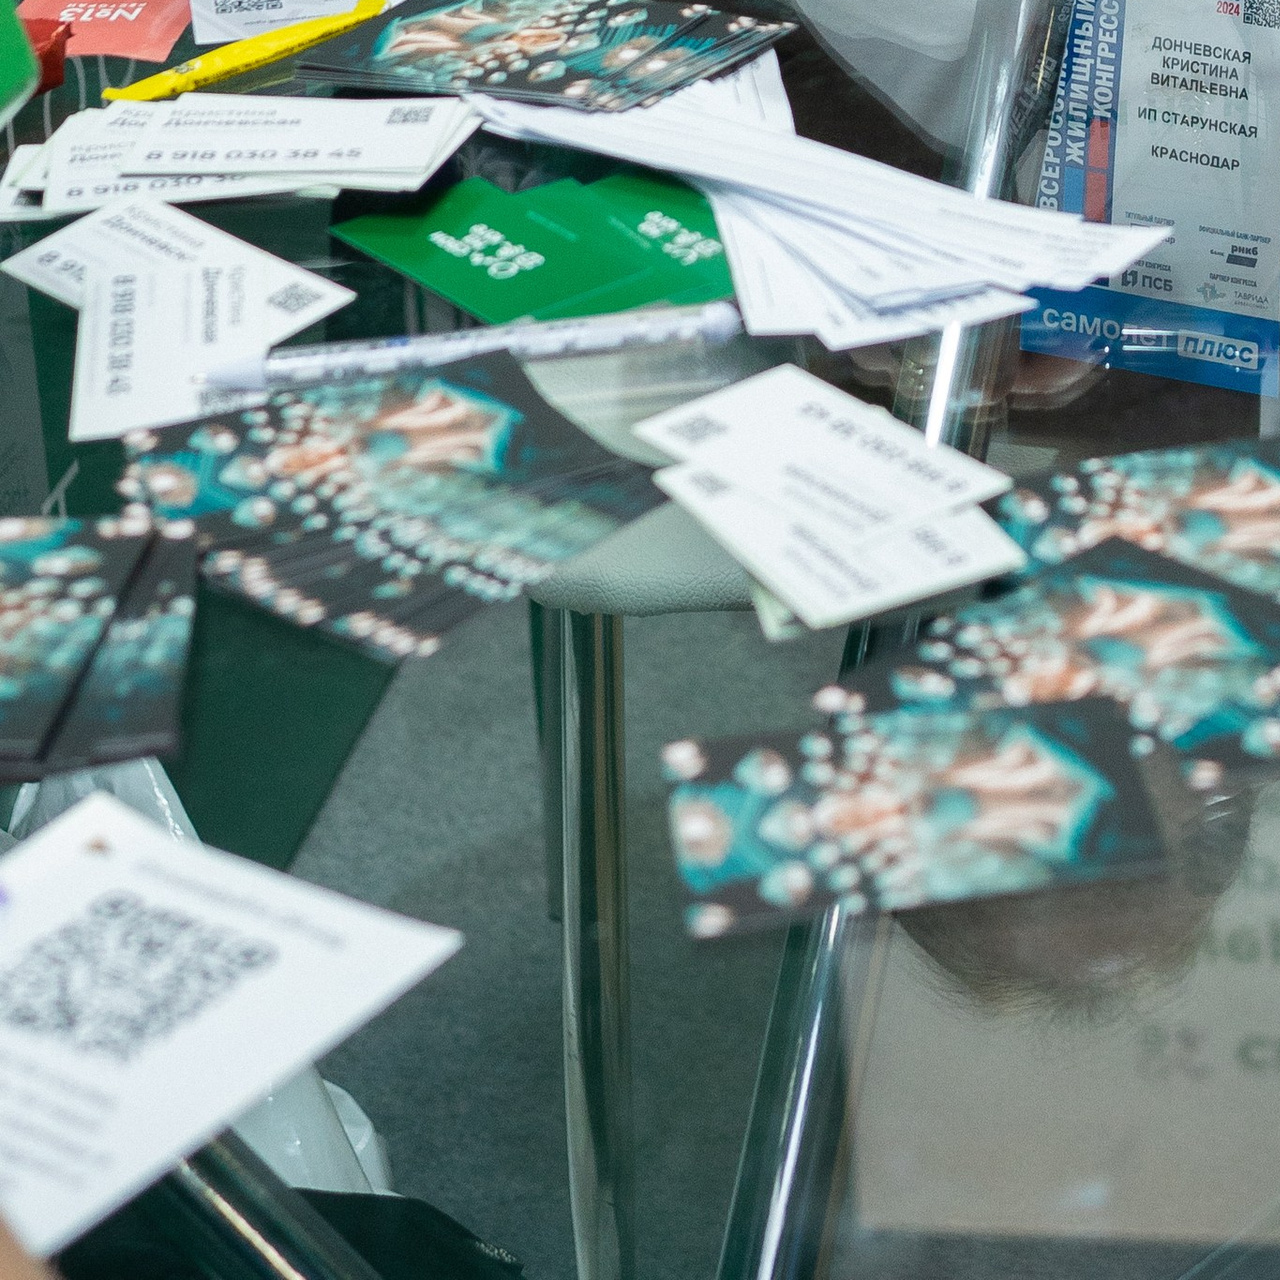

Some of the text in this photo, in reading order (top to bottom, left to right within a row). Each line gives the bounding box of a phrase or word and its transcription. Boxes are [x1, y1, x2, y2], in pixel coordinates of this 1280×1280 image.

[1216, 0, 1241, 17] 2024
[1151, 36, 1252, 65] ДОНЧЕВСКАЯ
[1161, 55, 1240, 81] КРИСТИНА
[1150, 71, 1249, 101] ВИТАЛЬЕВНА
[1137, 106, 1258, 139] ИП СТАРУНСКАЯ
[1151, 144, 1240, 171] КРАСНОДАР
[1231, 244, 1258, 256] рнкб
[1142, 274, 1173, 292] ПСБ
[1234, 290, 1269, 304] ТАВРИДА
[1183, 337, 1254, 363] плюс
